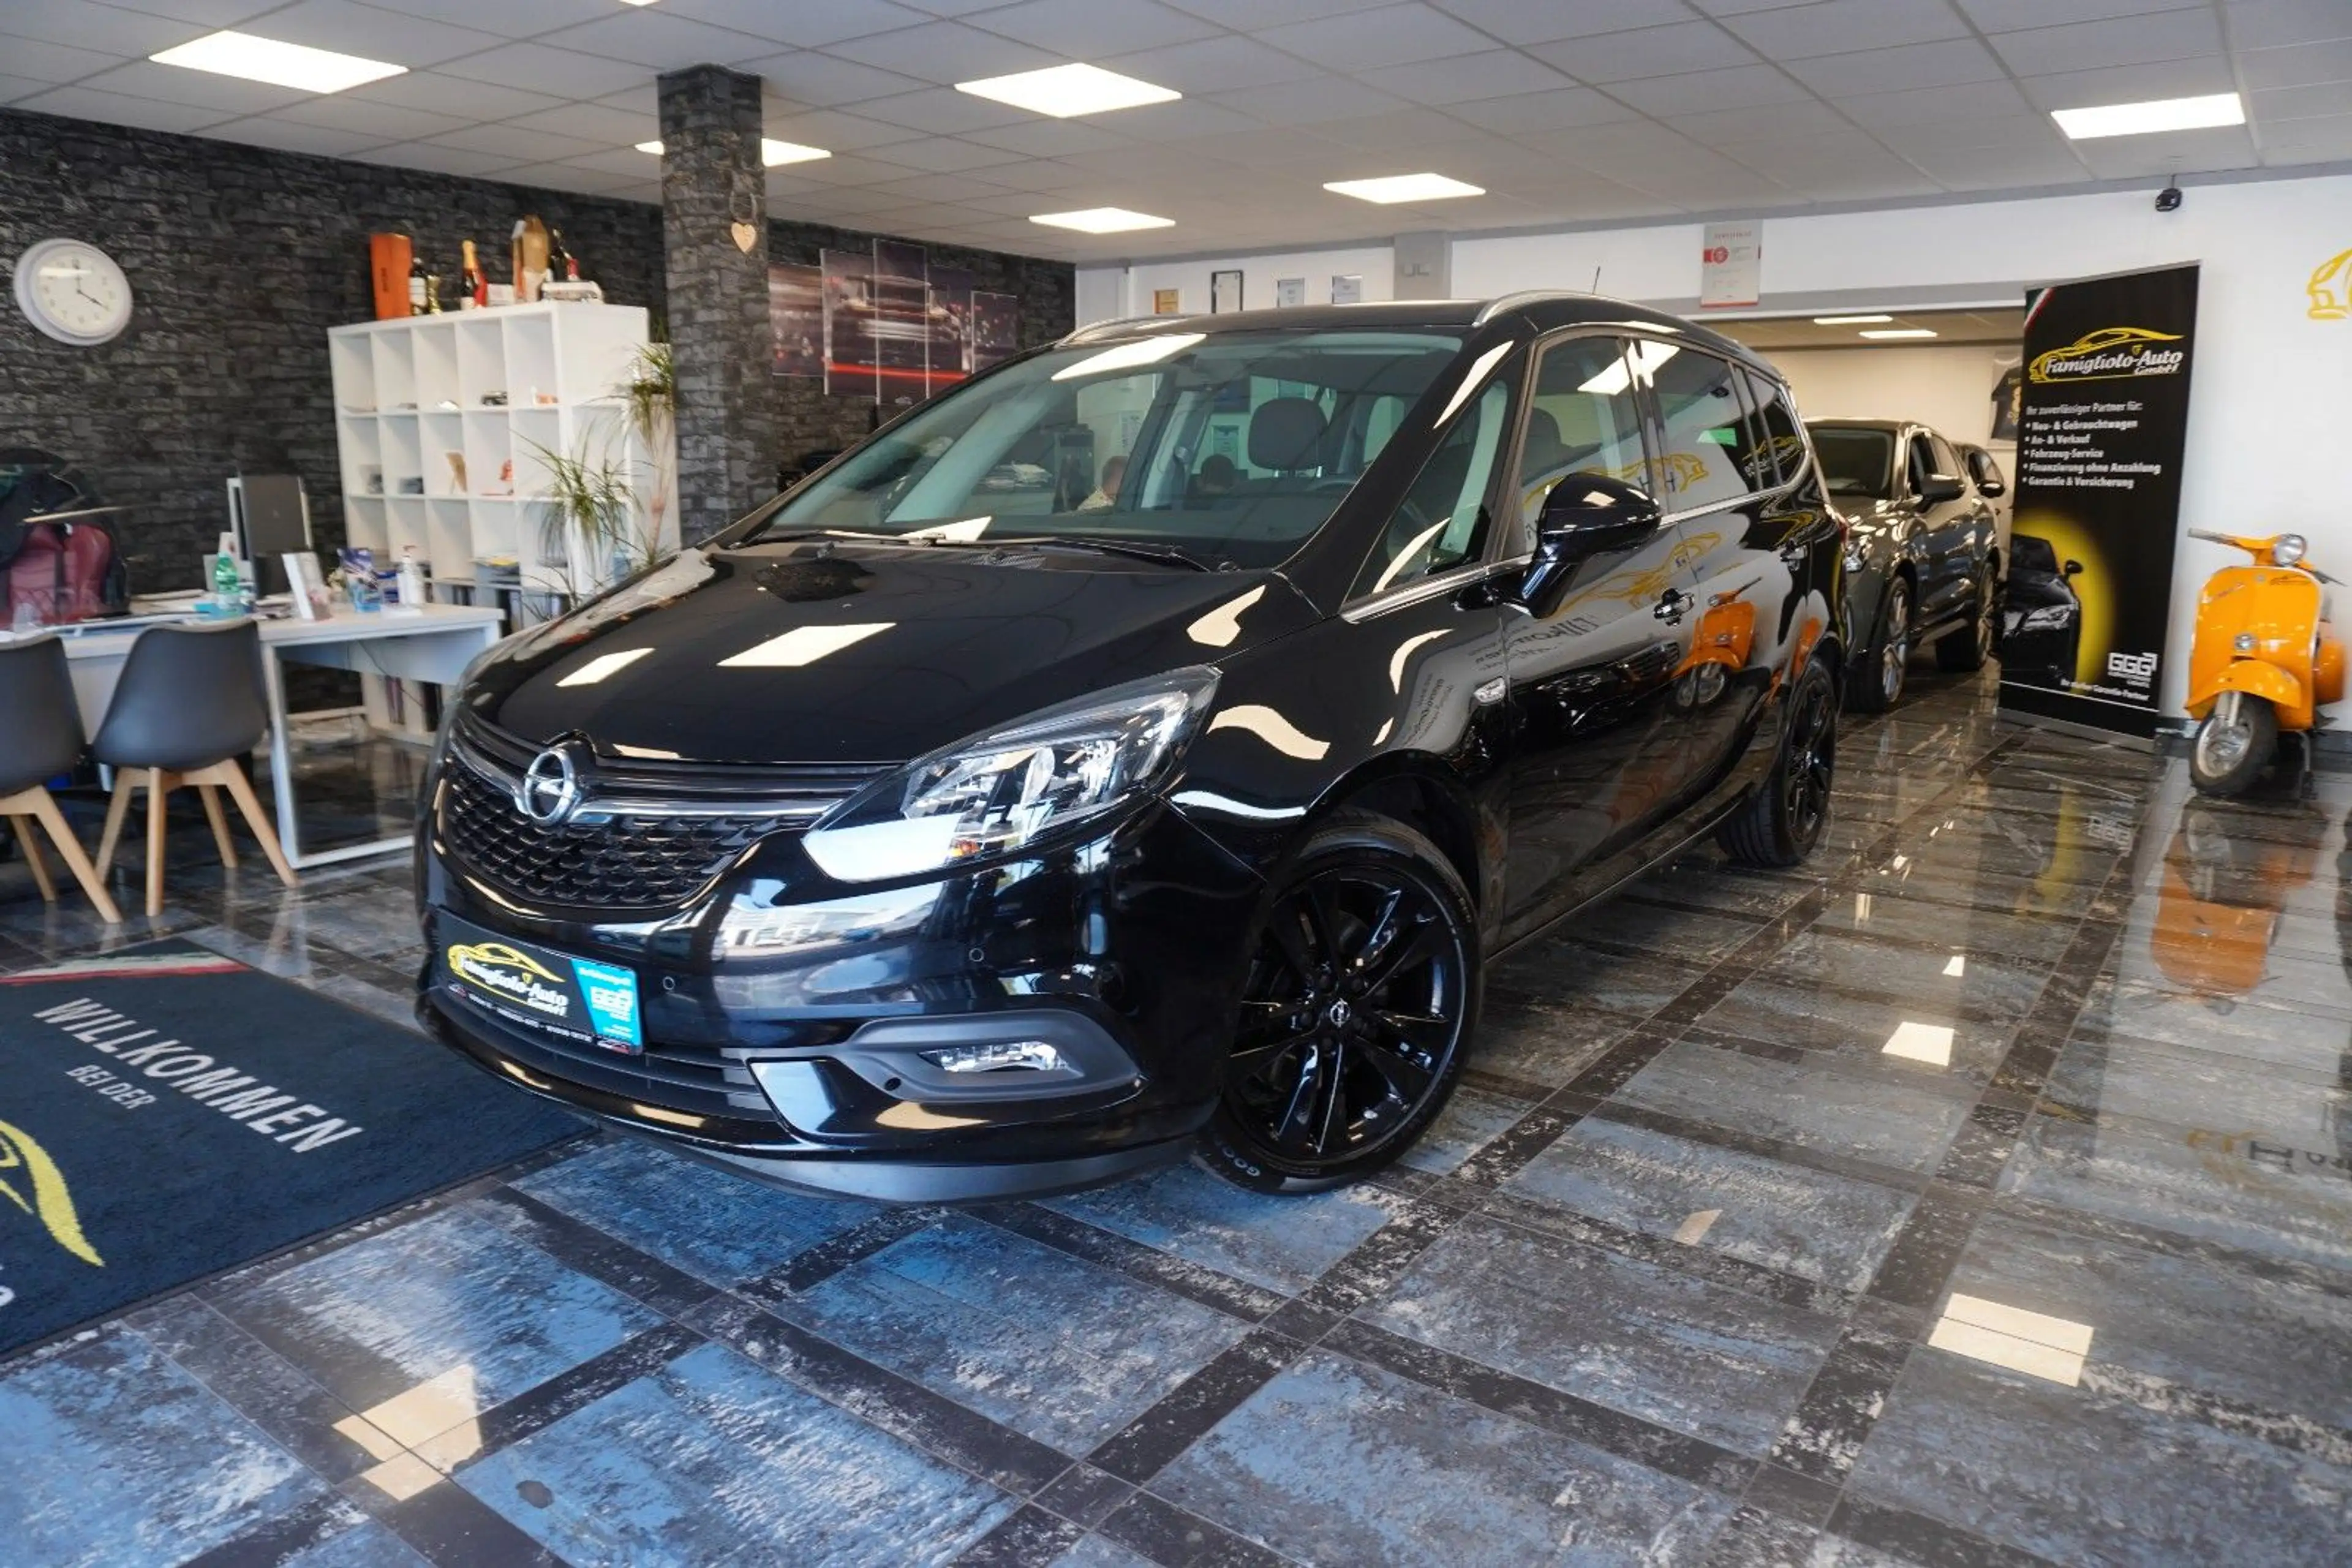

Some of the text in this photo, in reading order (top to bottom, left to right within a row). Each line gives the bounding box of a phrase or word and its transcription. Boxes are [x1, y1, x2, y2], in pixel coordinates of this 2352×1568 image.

[2045, 349, 2184, 375] Famigliolo-Auto
[2092, 402, 2126, 413] Partner
[2053, 421, 2062, 430] &
[2062, 420, 2138, 431] Gebrauchtwagen
[2047, 434, 2055, 444] &
[2056, 434, 2091, 444] Verkauf
[2030, 448, 2105, 461] Fahrzeug-Service
[2029, 462, 2162, 475] Finanzierung ohne Anzahlung
[2028, 477, 2065, 486] Garantie
[2075, 476, 2135, 489] Versicherung
[32, 997, 363, 1153] WILLKOMMEN
[64, 1064, 157, 1109] BEI DER
